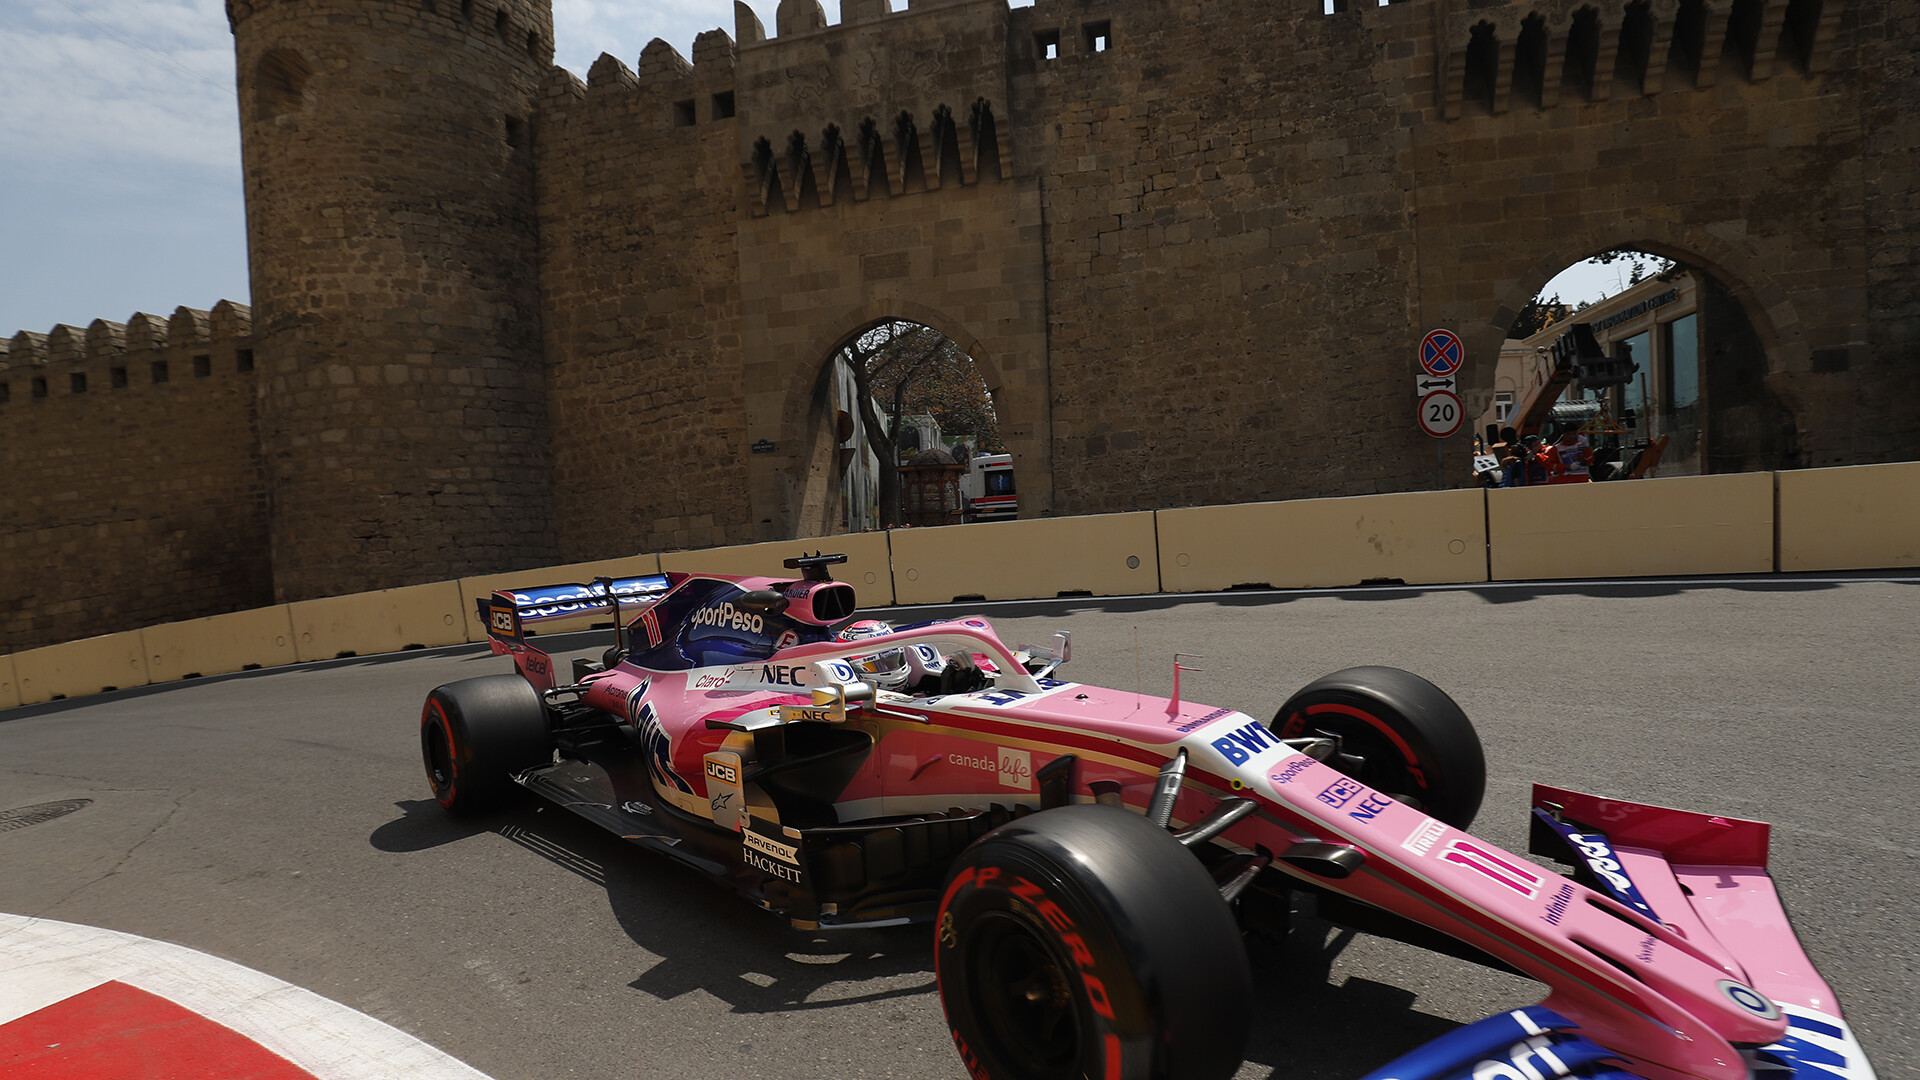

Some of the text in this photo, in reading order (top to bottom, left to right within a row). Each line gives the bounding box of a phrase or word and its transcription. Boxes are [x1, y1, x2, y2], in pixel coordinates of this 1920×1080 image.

[1429, 403, 1454, 422] 20
[641, 608, 663, 649] 11
[525, 656, 547, 675] telcel
[695, 672, 729, 688] Claro
[760, 665, 806, 687] NEC
[802, 710, 830, 721] NEC
[1211, 721, 1282, 767] BWT
[708, 762, 736, 782] JCB
[948, 754, 1032, 784] canada life
[1271, 757, 1317, 784] SportPesa
[1319, 778, 1362, 808] JCB
[1348, 793, 1393, 824] NEC
[748, 835, 792, 859] RAVENOL
[1401, 817, 1448, 857] PIRELLI
[743, 847, 801, 883] HACKETT
[1437, 839, 1545, 900] 11
[1008, 875, 1116, 1021] ZERO
